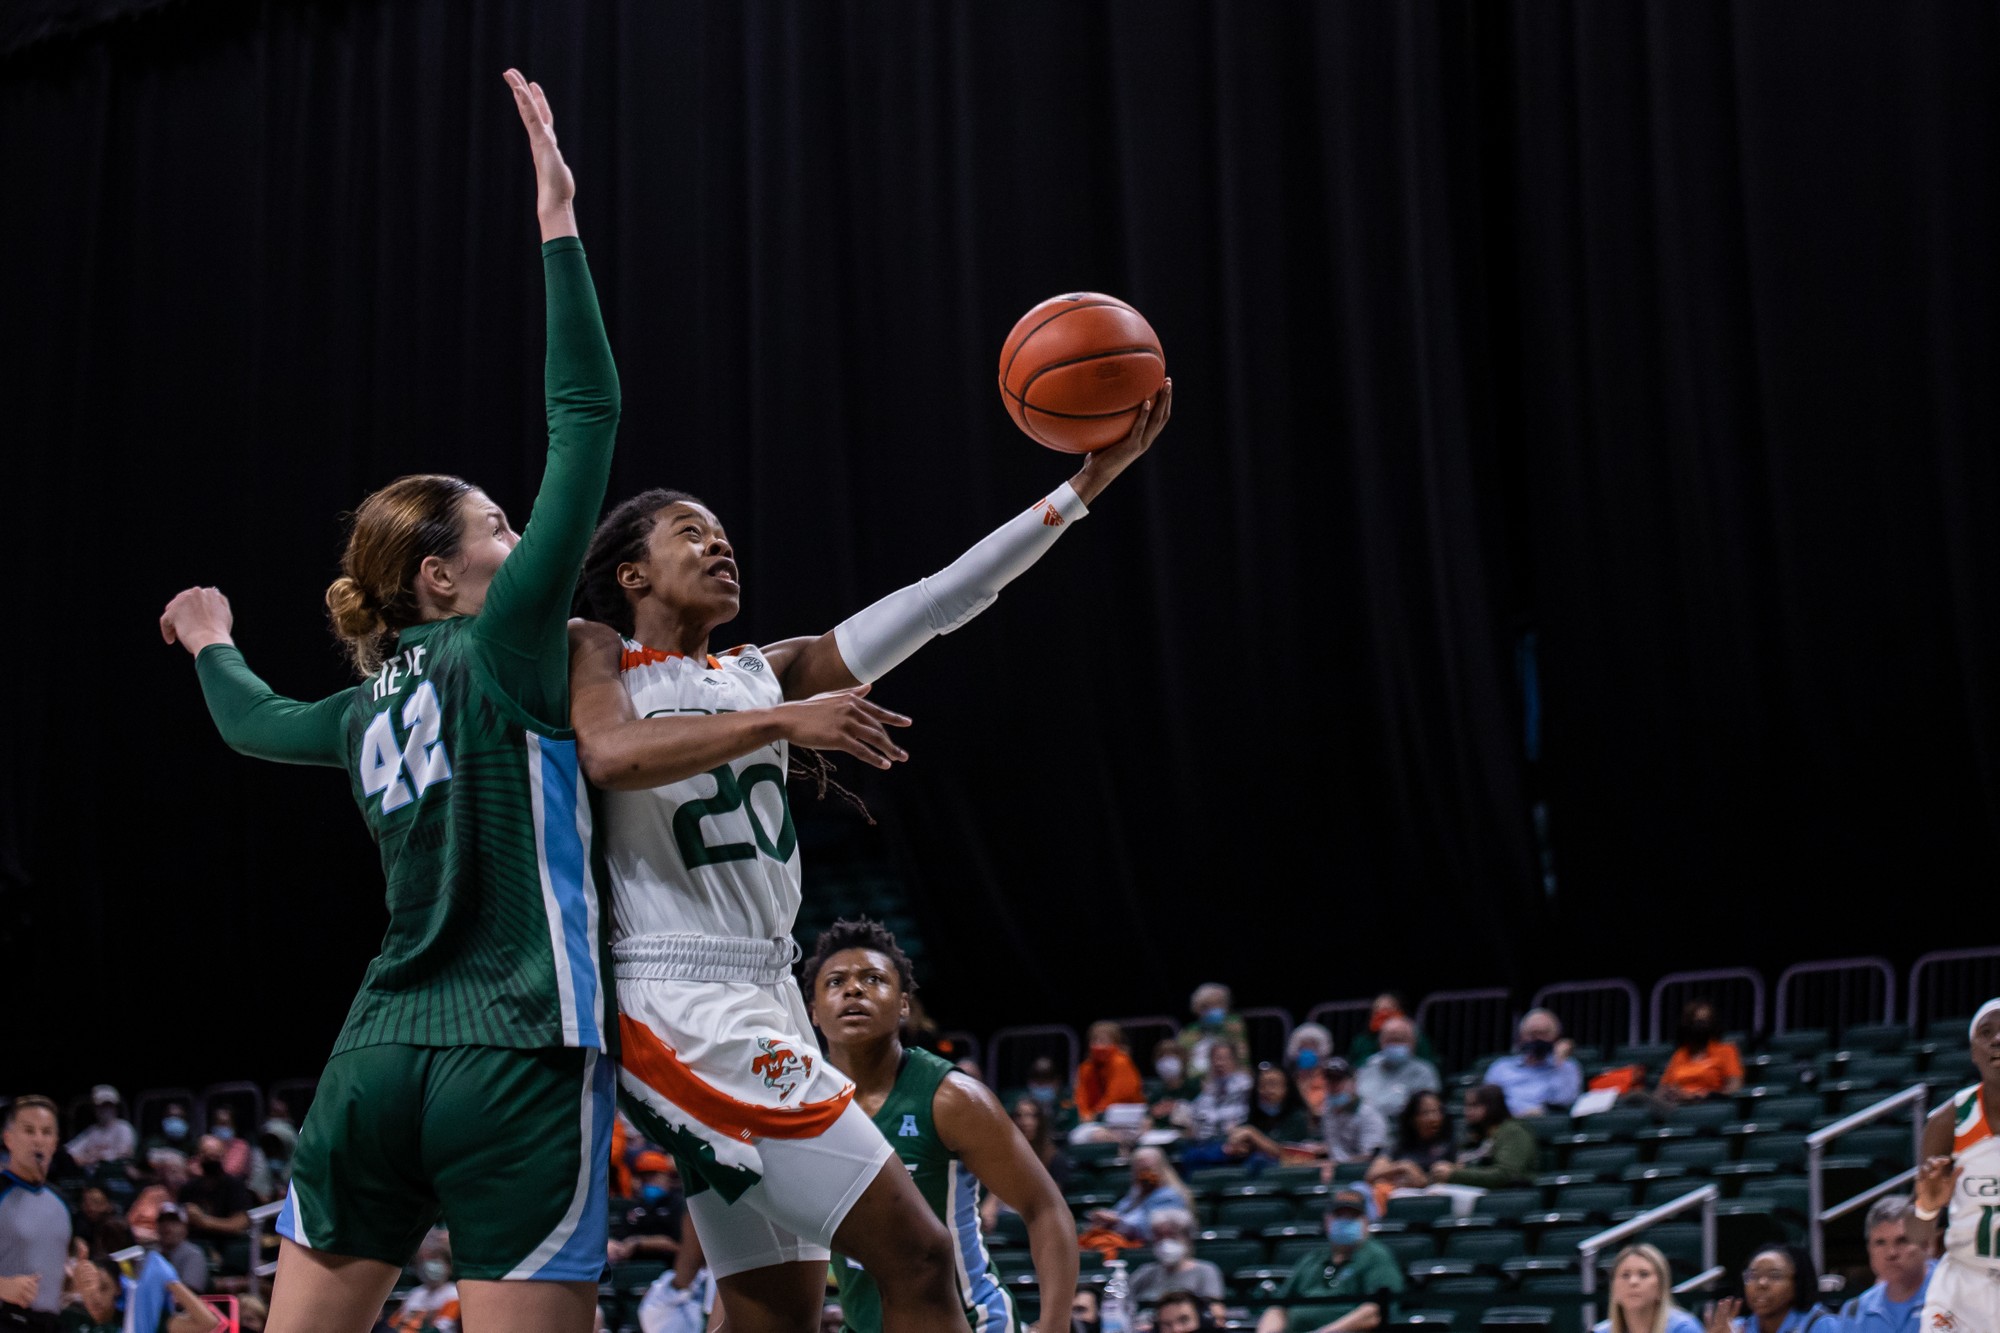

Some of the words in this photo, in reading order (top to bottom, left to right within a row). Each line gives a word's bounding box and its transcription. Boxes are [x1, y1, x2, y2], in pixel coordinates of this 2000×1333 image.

[360, 679, 452, 816] 42
[672, 762, 797, 871] 20
[899, 1114, 919, 1137] A
